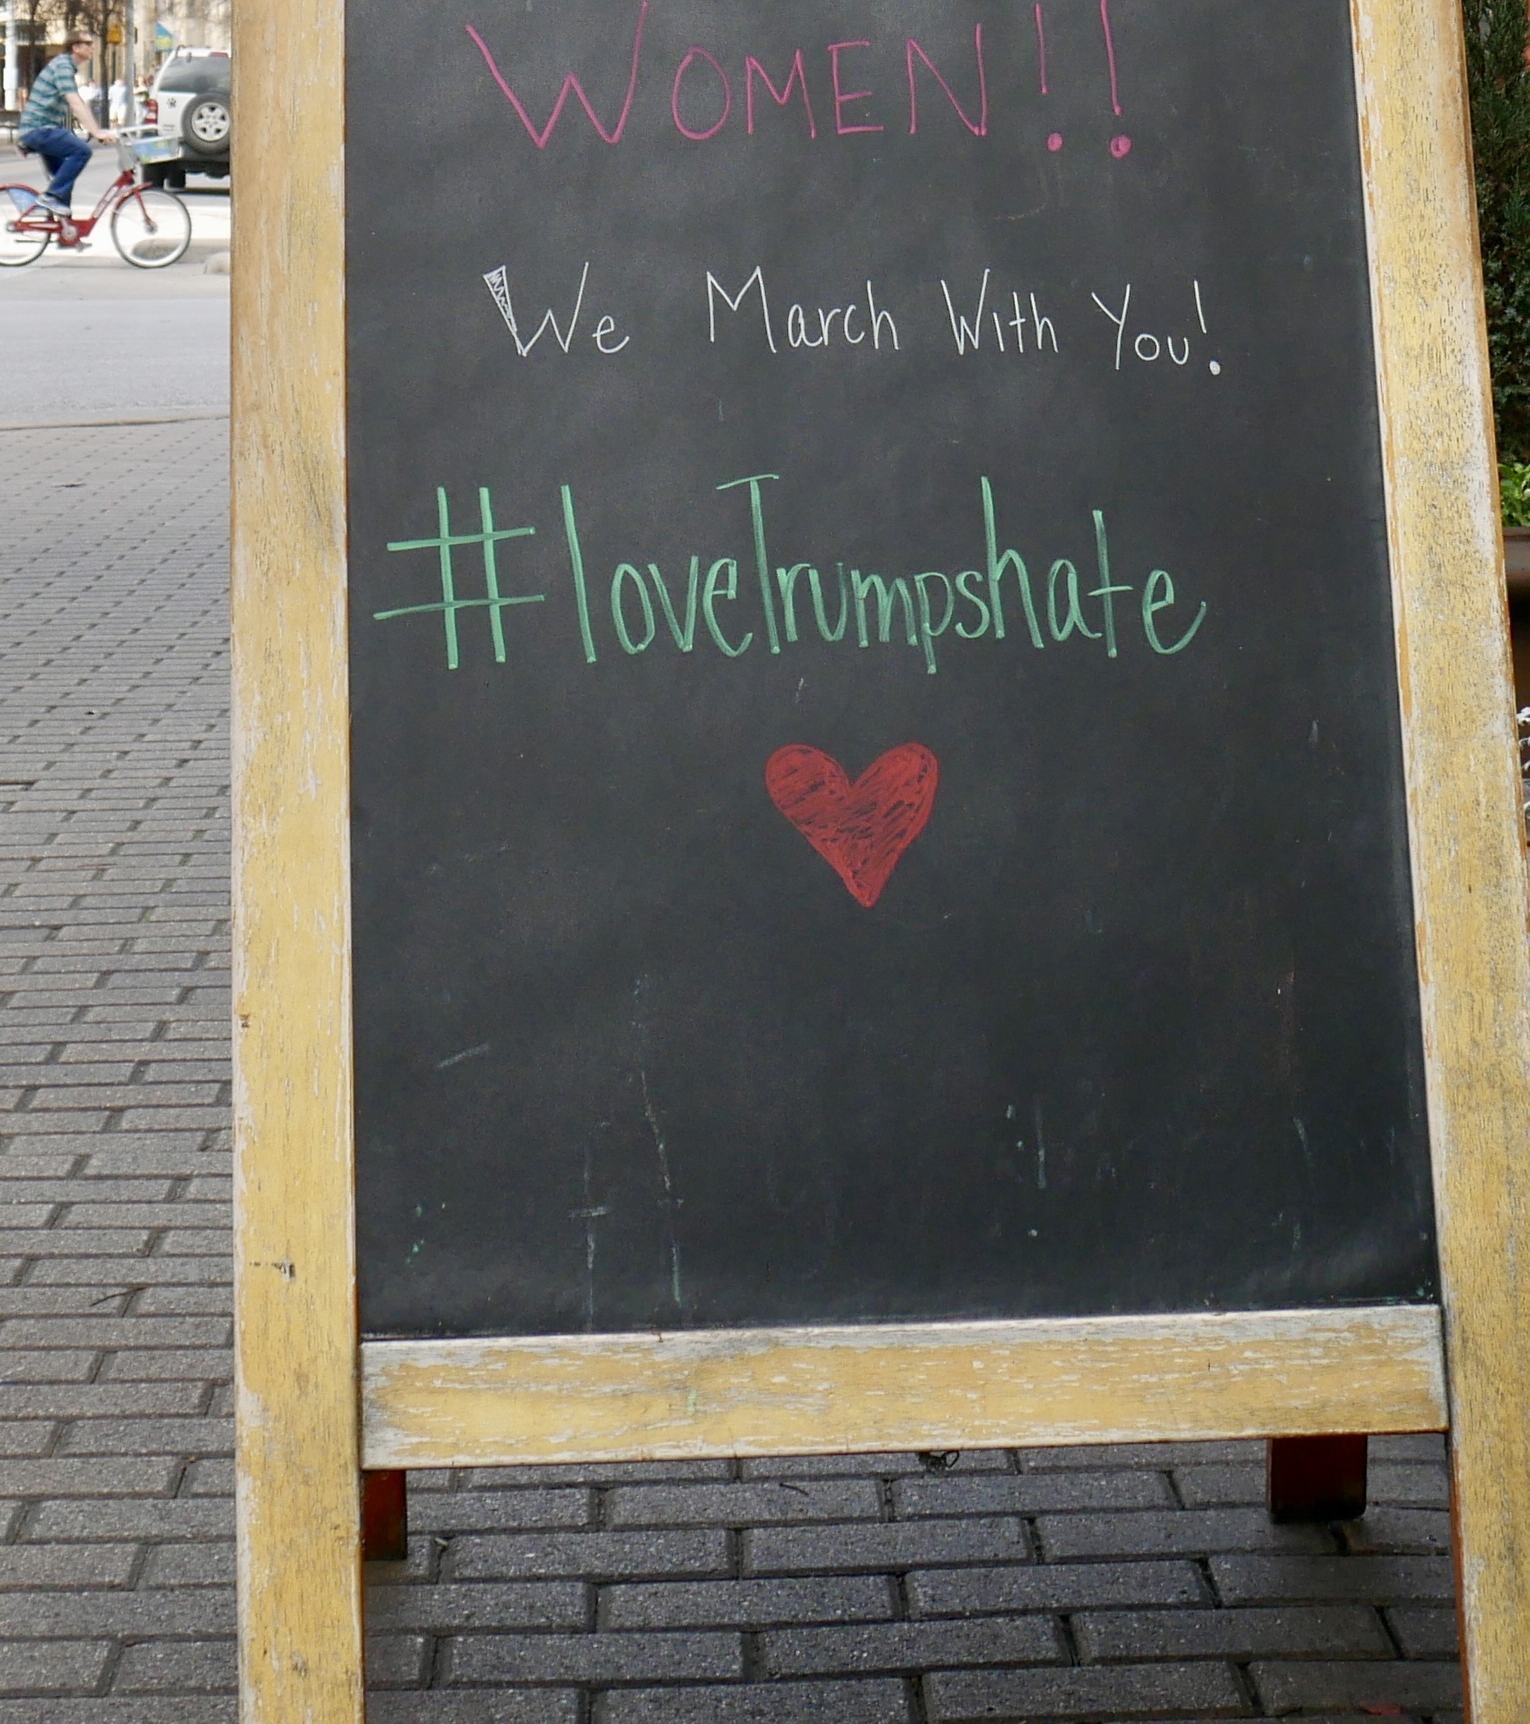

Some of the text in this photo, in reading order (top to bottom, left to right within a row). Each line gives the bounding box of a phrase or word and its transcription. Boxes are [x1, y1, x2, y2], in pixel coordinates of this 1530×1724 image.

[482, 262, 1222, 376] We March With You!
[372, 473, 1208, 674] #loveTrumpshate
